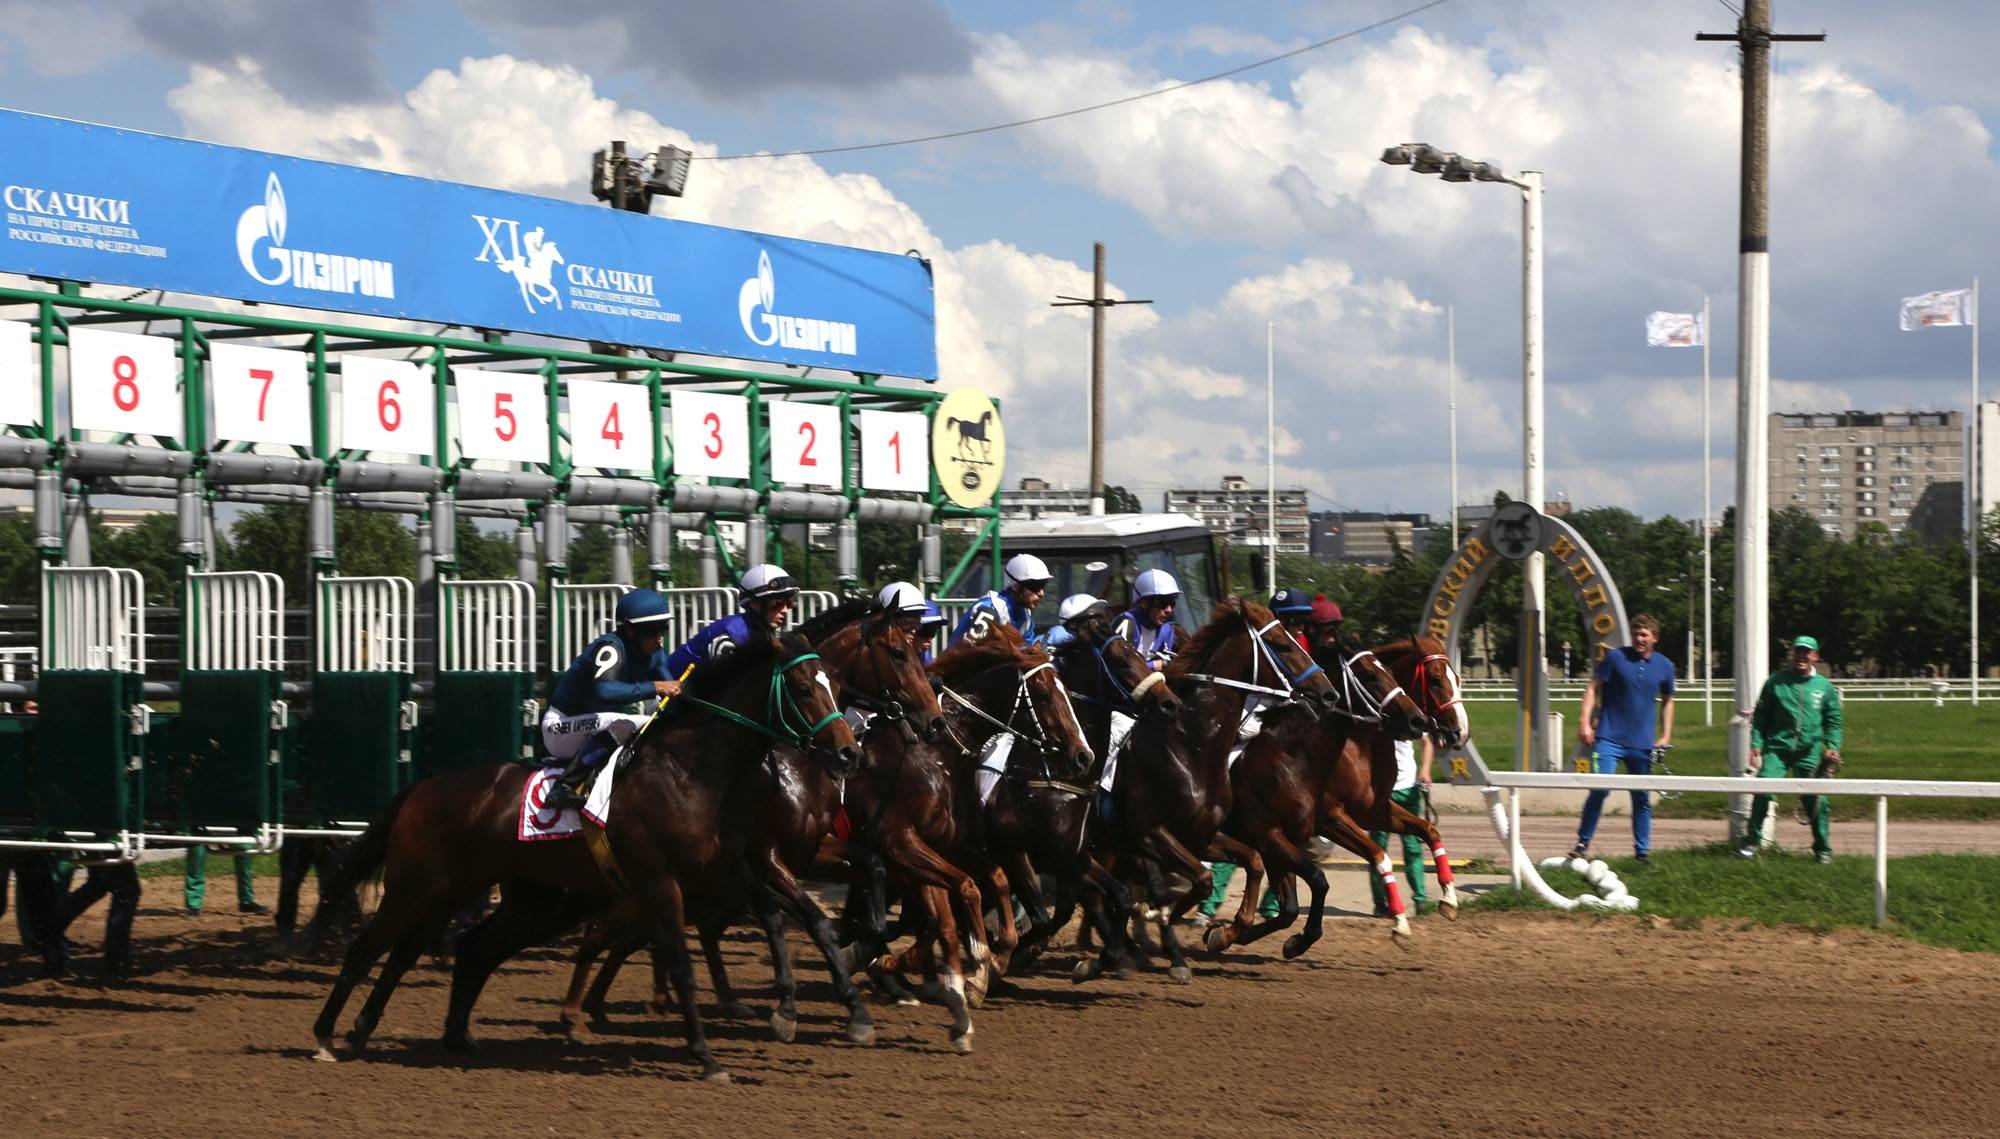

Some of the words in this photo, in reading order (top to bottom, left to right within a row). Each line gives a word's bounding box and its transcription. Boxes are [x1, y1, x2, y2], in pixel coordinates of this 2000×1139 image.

[4, 185, 132, 225] СКАЧКИ
[471, 214, 521, 263] XI
[566, 263, 655, 296] СКАЧКИ
[113, 355, 139, 412] 8
[250, 369, 274, 421] 7
[378, 380, 401, 432] 6
[495, 393, 517, 442] 5
[602, 402, 623, 449] 4
[704, 412, 723, 459] 3
[799, 422, 817, 466] 2
[888, 431, 901, 474] 1
[970, 611, 995, 639] 5
[1115, 619, 1129, 641] 1
[594, 645, 619, 679] 9
